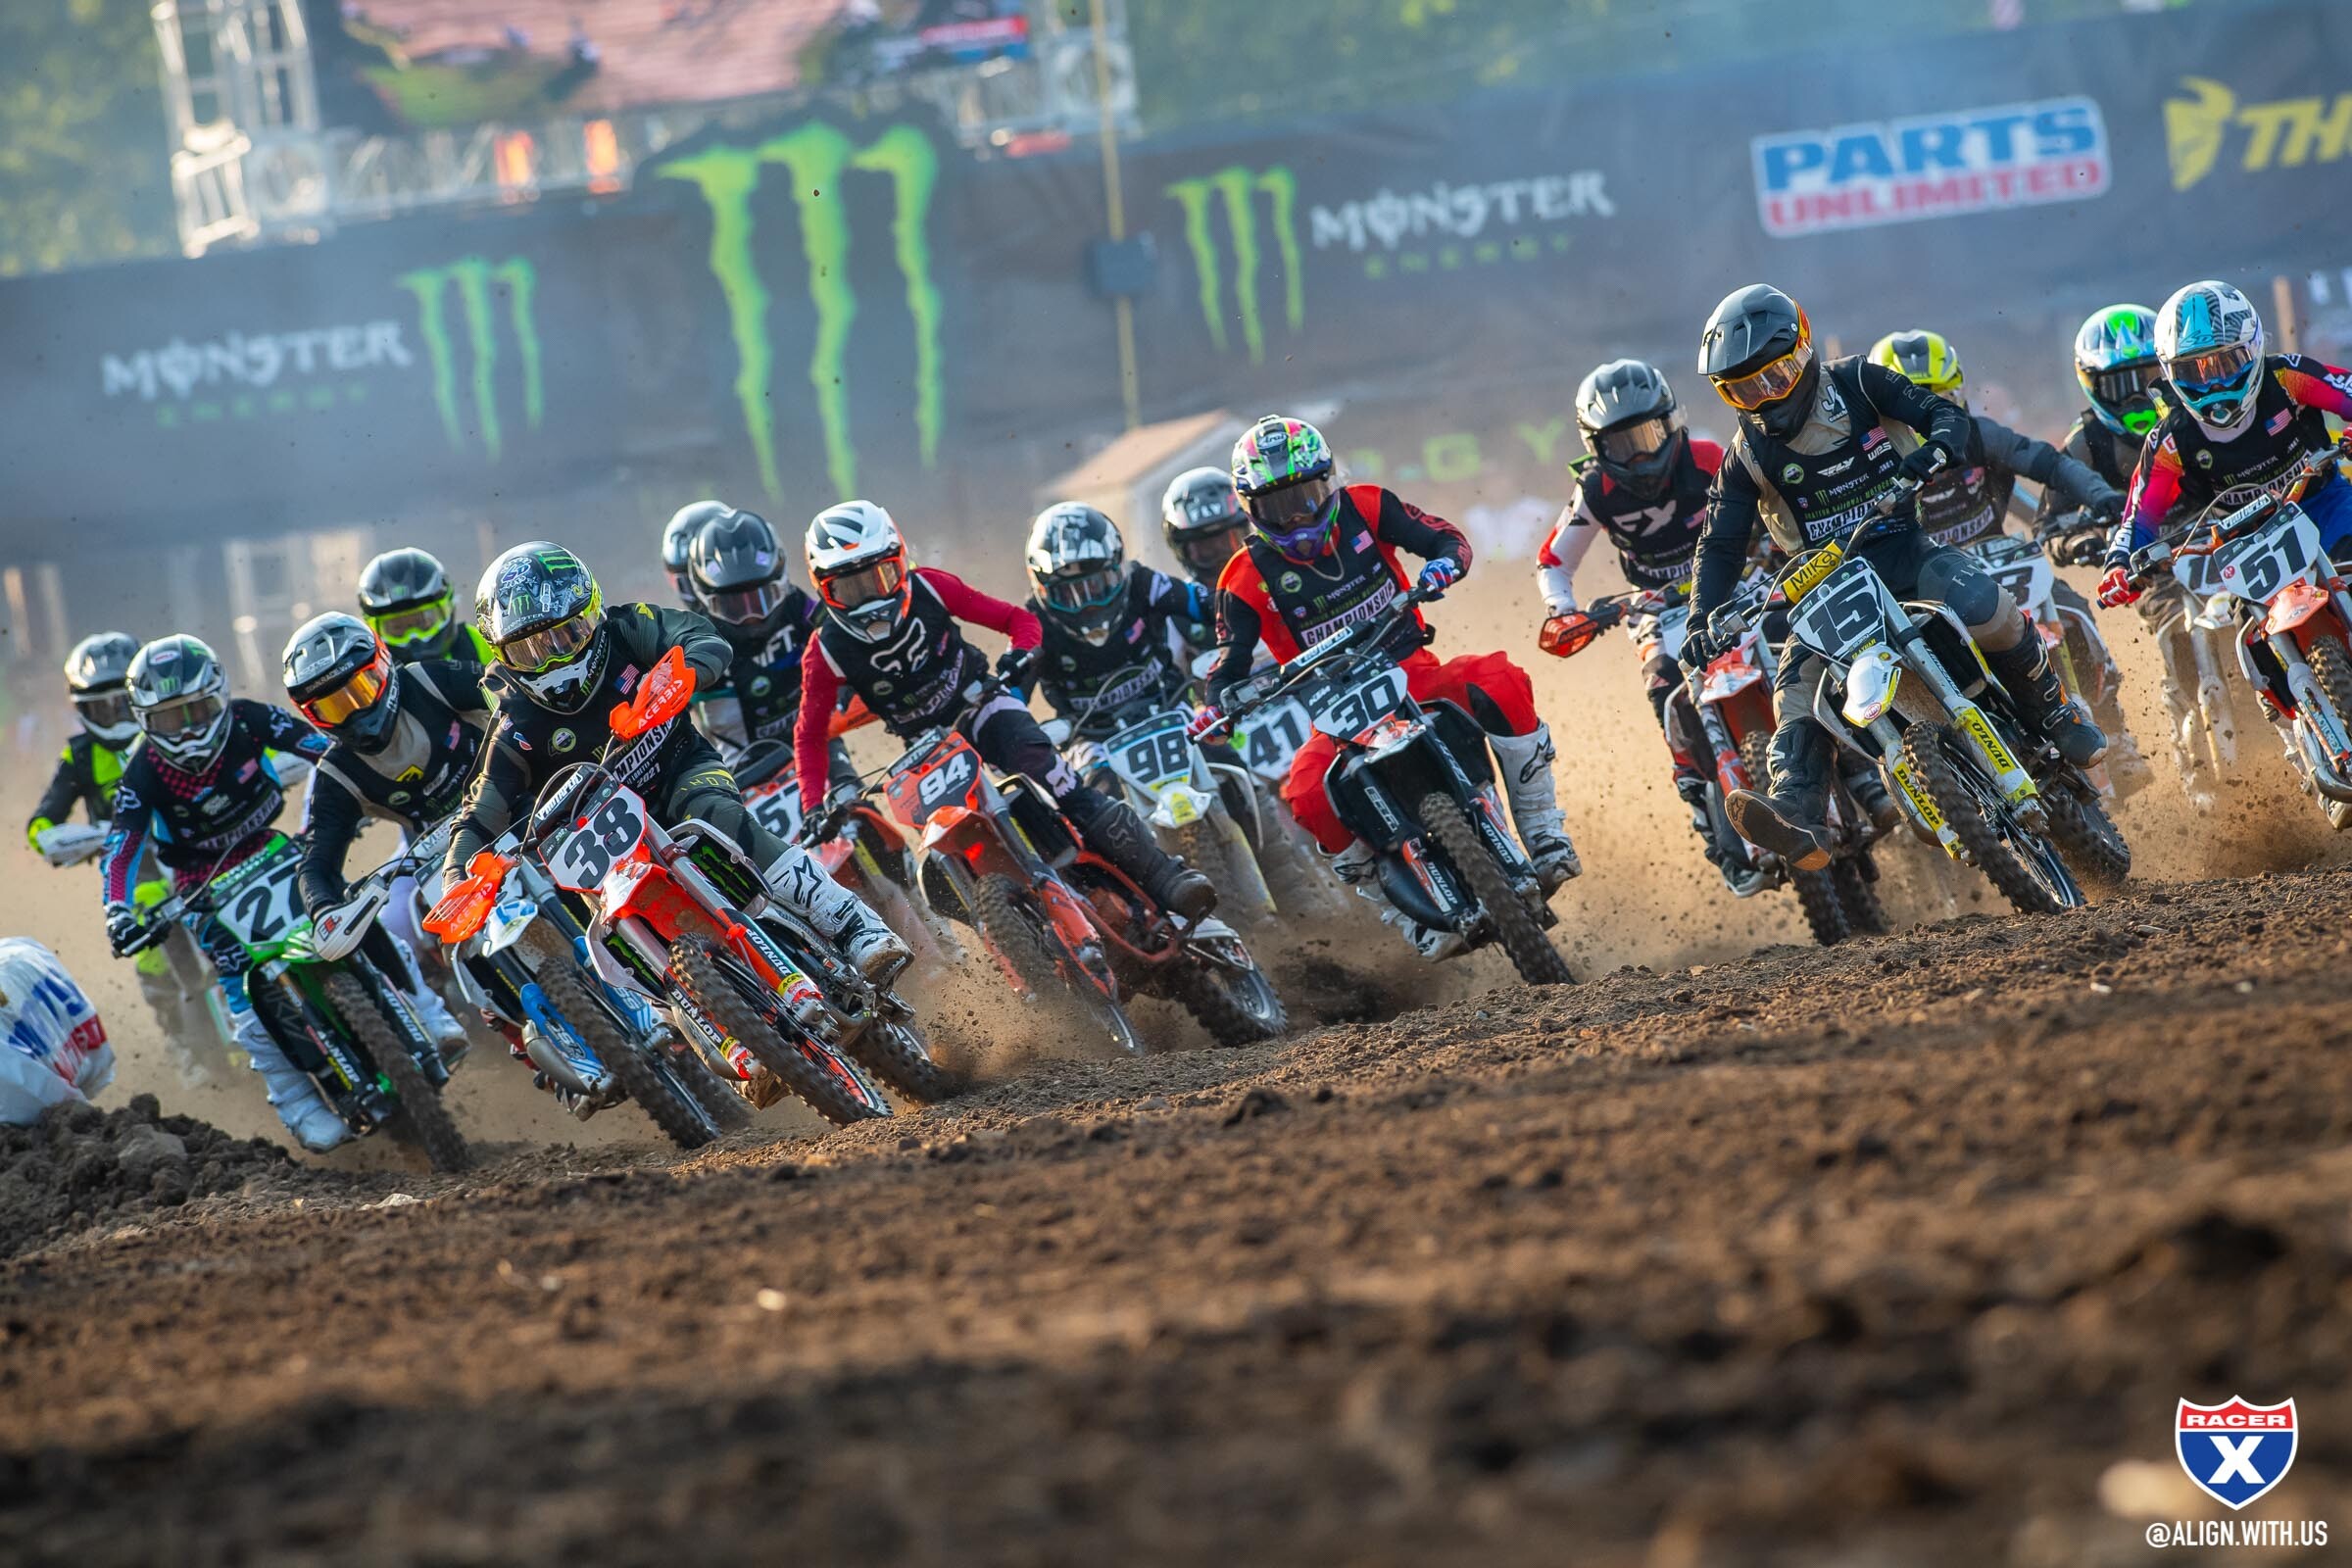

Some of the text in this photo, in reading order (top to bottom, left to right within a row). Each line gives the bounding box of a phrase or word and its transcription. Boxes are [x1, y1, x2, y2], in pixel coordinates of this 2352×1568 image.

[1763, 107, 2096, 191] PARTS
[2238, 93, 2352, 172] TH
[1309, 170, 1615, 252] MONSTER
[1769, 159, 2101, 227] UNLIMITED
[102, 320, 414, 400] MONSTER
[1829, 473, 1870, 497] MONSTER
[2236, 455, 2279, 478] MONSTER
[1327, 574, 1367, 602] MONSTER
[1789, 552, 1834, 592] MIKO
[2239, 525, 2307, 601] 51
[1306, 582, 1396, 645] CHAMPIONSHIP
[1806, 574, 1883, 659] 15
[637, 678, 683, 730] ACERBIS
[1331, 673, 1401, 742] 30
[1127, 729, 1191, 785] 98
[1250, 710, 1304, 768] 41
[1970, 719, 2014, 769] DUNLO
[919, 752, 972, 806] 94
[1896, 767, 1940, 827] DUNLOP
[564, 796, 644, 891] 38
[1482, 820, 1514, 866] DUNLOP
[1426, 861, 1458, 906] DUNLOP
[745, 928, 790, 975] DUNLOP
[382, 987, 425, 1043] DUNLOP
[671, 988, 721, 1044] DUNLOP
